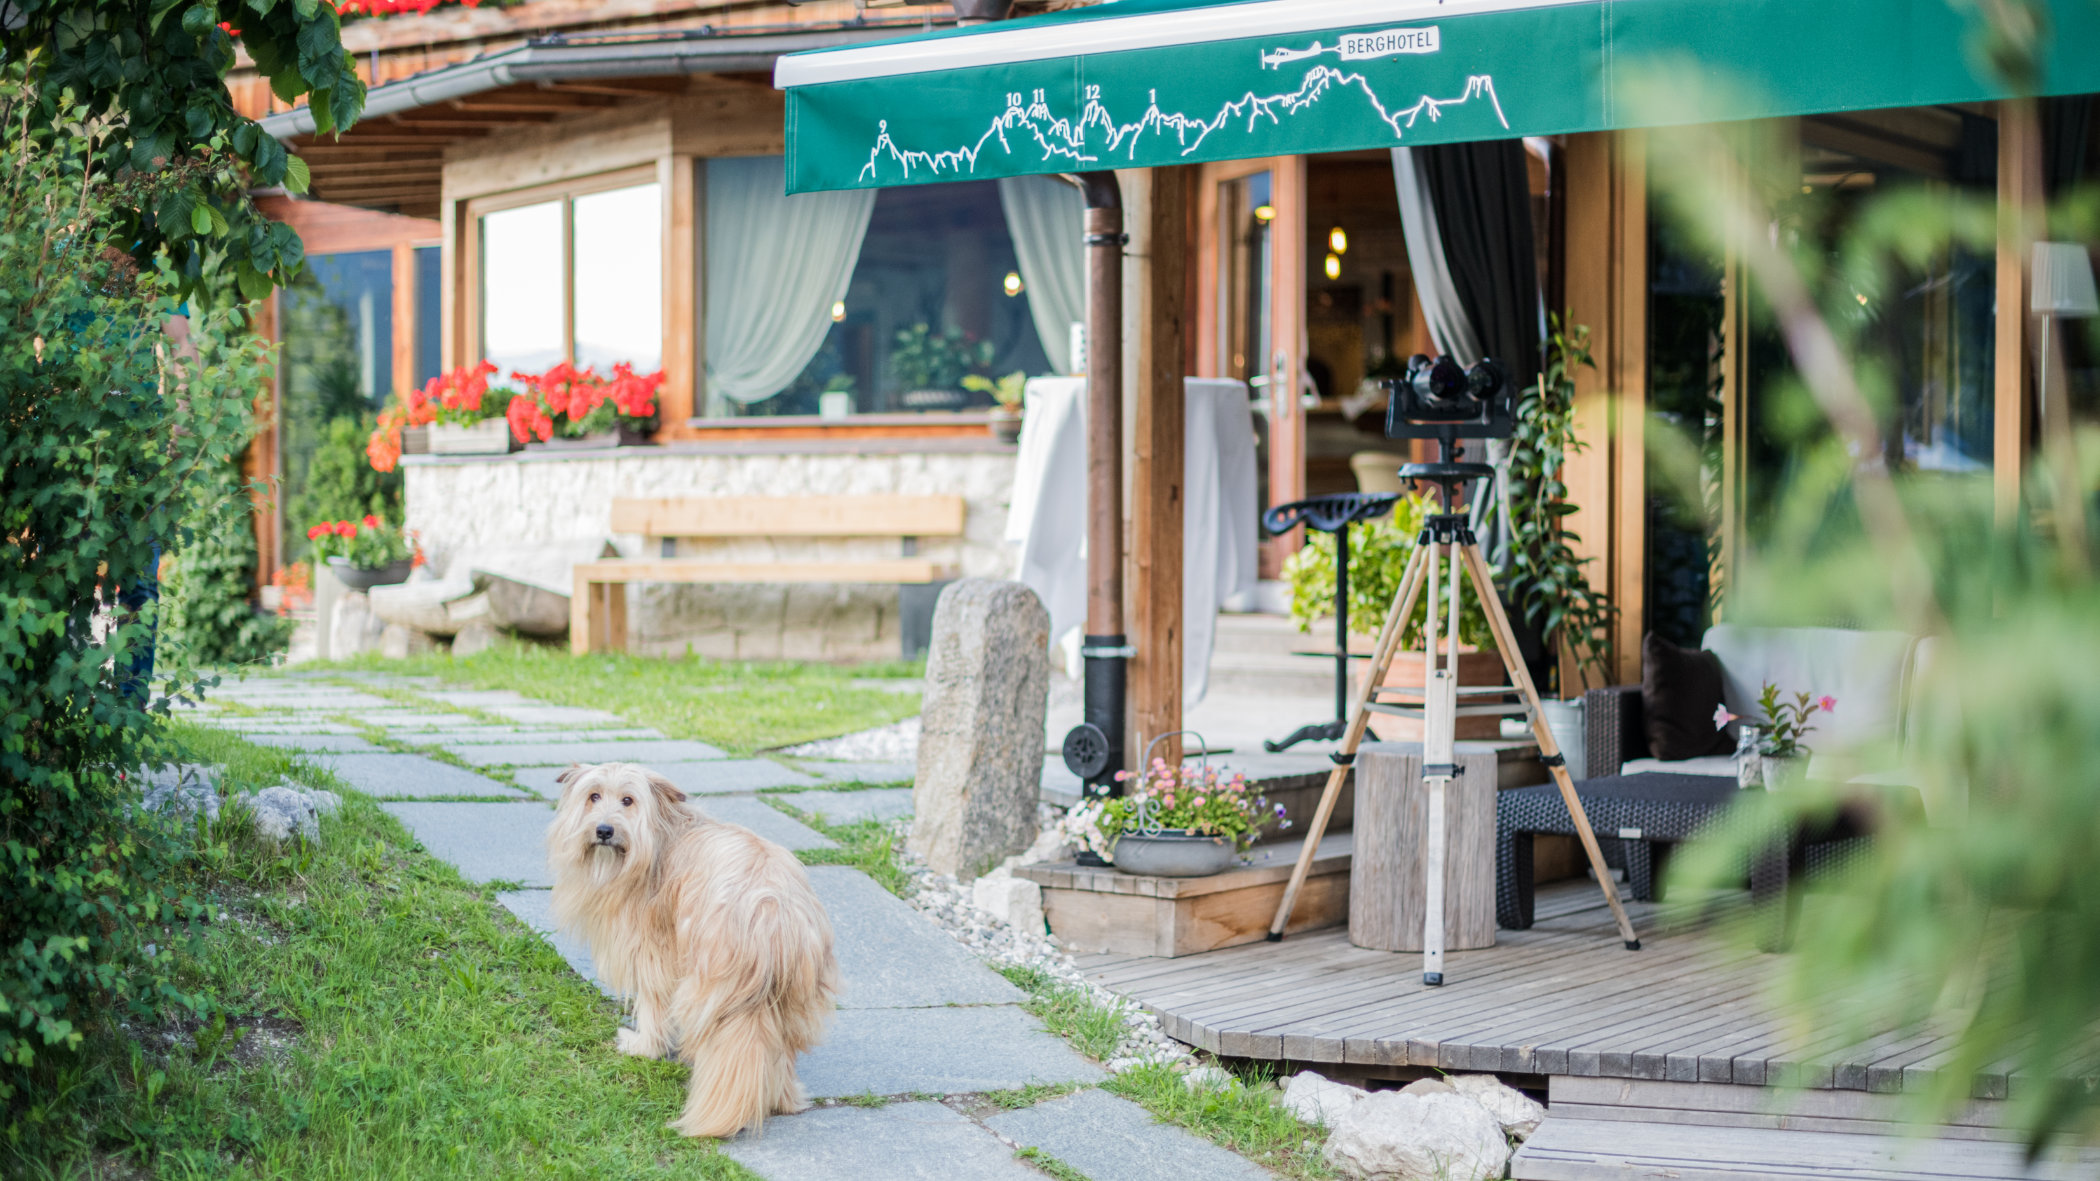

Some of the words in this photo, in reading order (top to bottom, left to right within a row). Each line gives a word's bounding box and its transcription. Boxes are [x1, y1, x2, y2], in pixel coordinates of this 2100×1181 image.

[1347, 31, 1433, 55] BERGHOTEL
[1006, 92, 1022, 106] 10
[1033, 88, 1045, 103] 11
[1085, 84, 1101, 100] 12
[1149, 88, 1156, 104] 1
